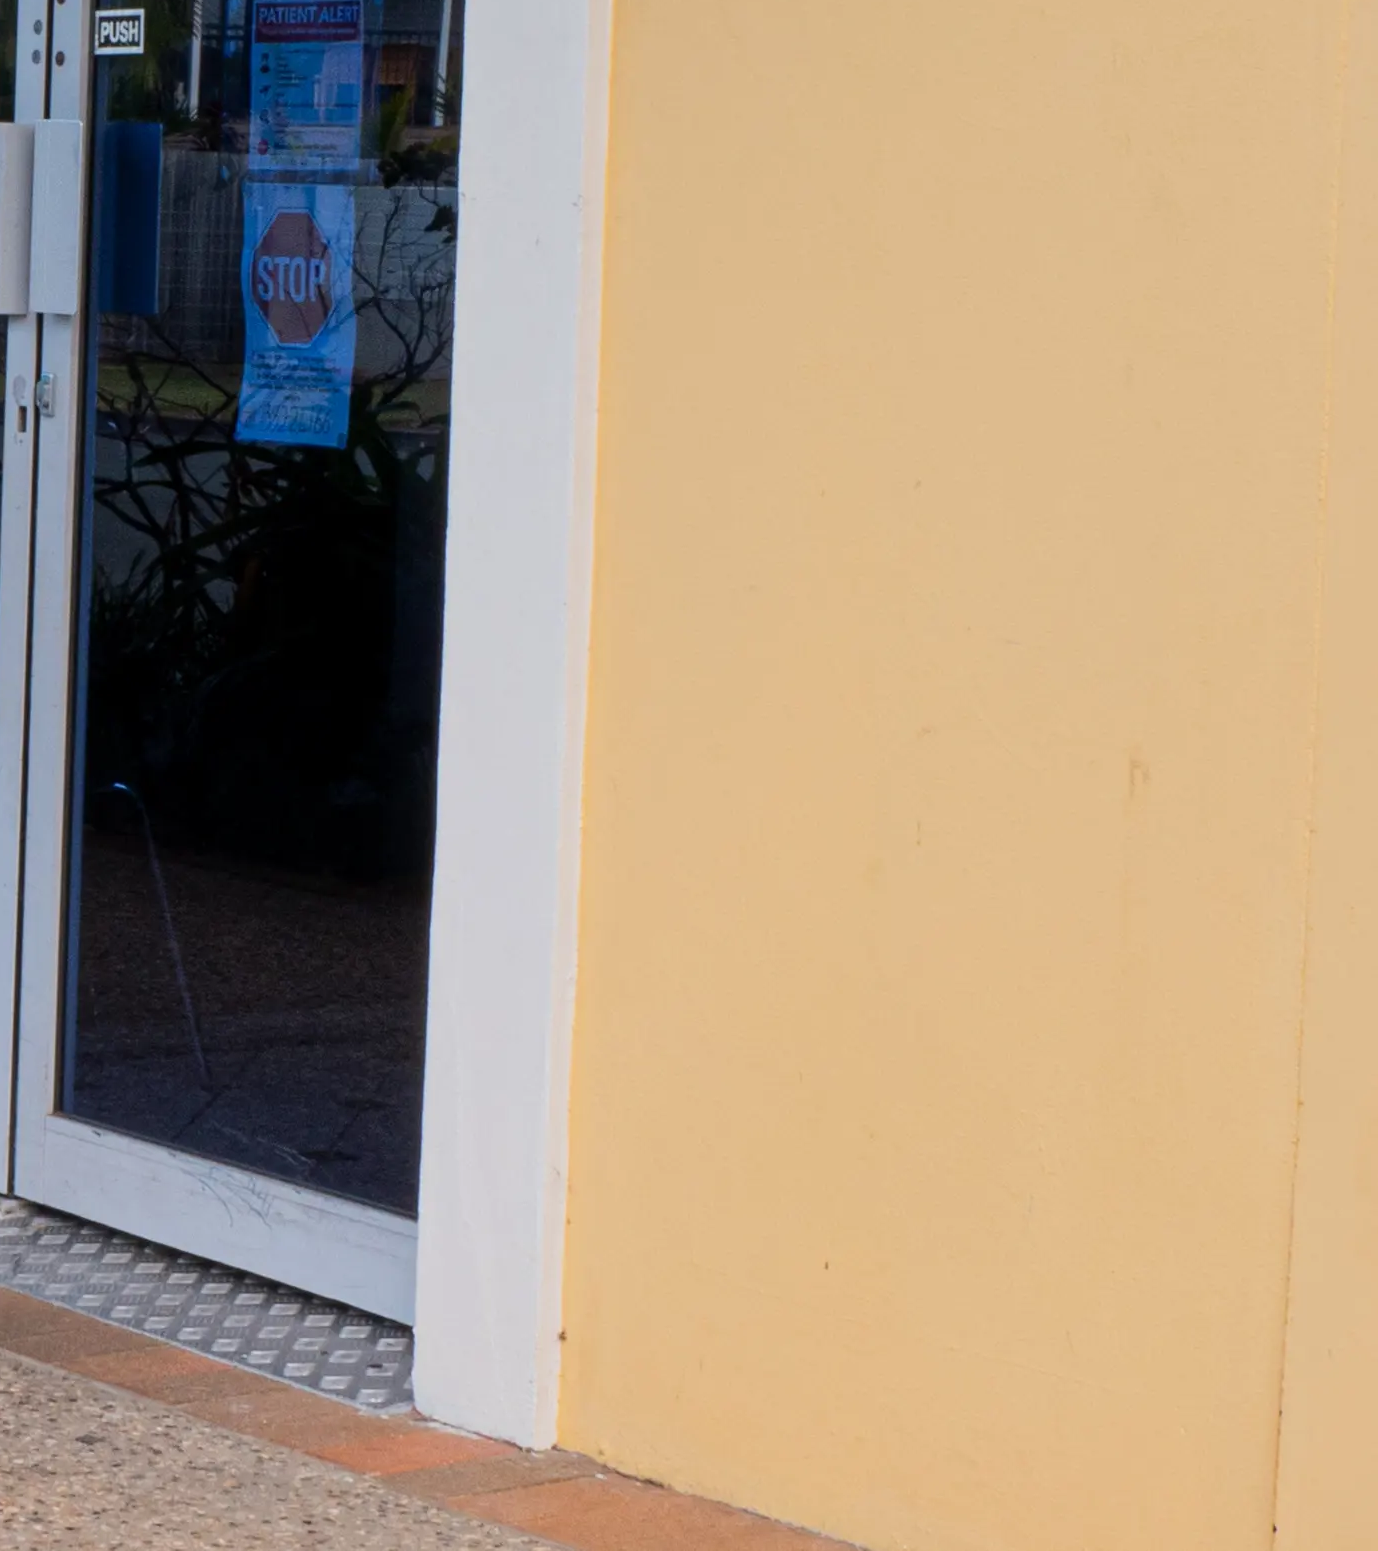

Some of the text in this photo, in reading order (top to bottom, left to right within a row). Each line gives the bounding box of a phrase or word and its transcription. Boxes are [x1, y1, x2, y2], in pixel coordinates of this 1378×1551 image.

[258, 5, 359, 24] PATIENT ALERT
[101, 20, 139, 43] PUSH
[257, 256, 326, 302] STOP
